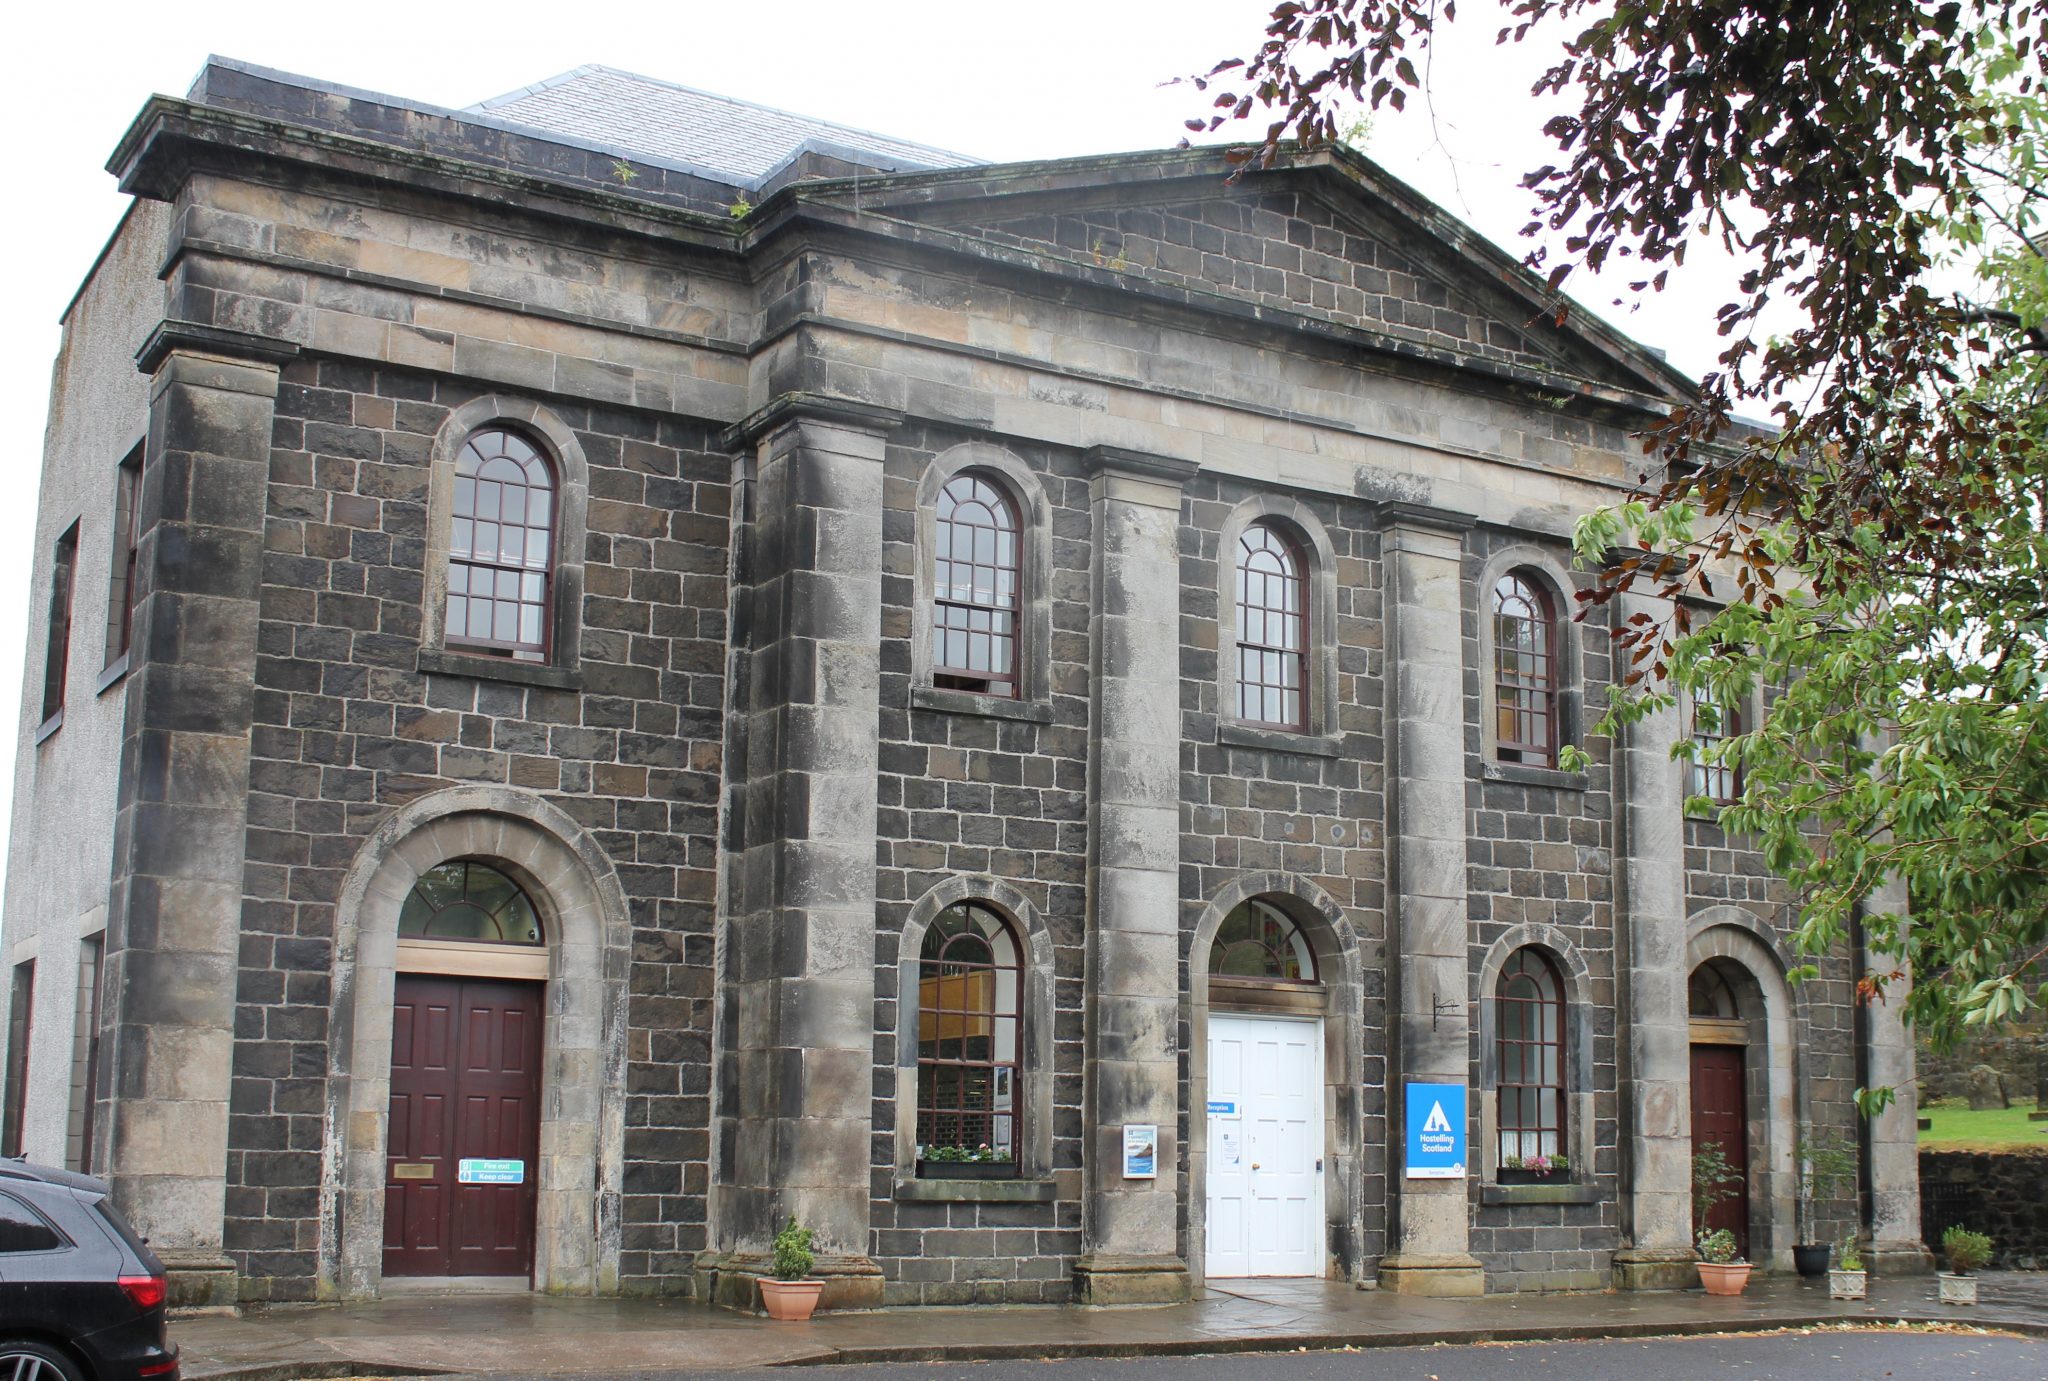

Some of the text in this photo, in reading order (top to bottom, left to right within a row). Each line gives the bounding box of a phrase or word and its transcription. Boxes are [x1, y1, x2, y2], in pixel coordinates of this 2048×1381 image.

[1420, 1134, 1454, 1144] Hostelling
[1422, 1144, 1452, 1152] Scotland
[498, 1162, 510, 1170] exit
[479, 1172, 497, 1180] Keep
